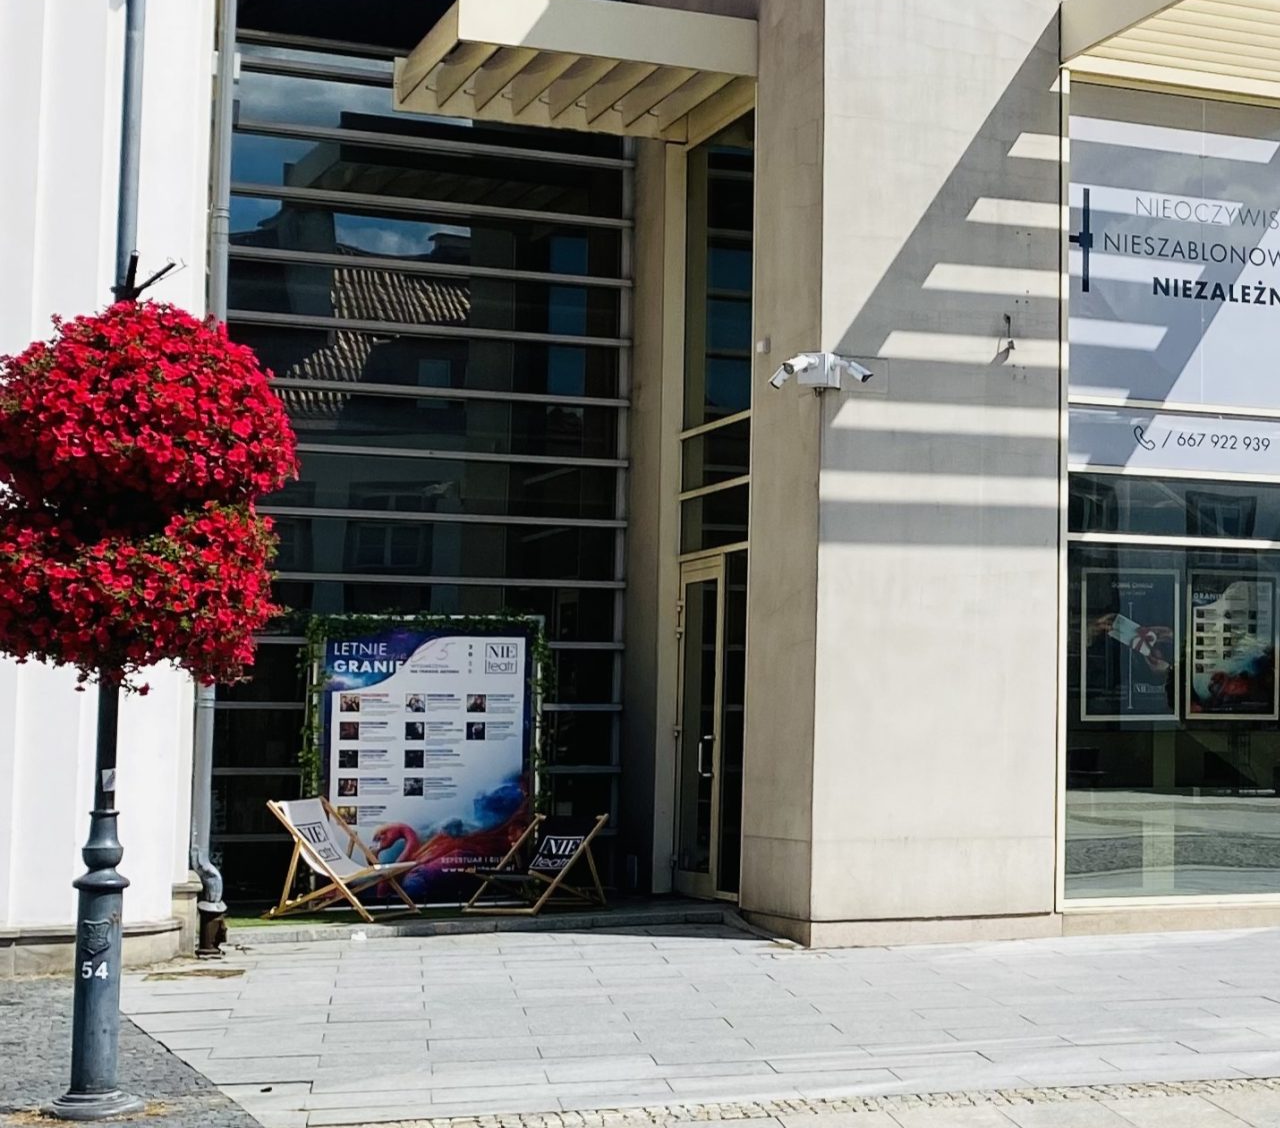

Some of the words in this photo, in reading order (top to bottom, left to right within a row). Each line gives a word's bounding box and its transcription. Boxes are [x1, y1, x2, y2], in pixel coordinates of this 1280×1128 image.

[1176, 433, 1206, 448] 667
[1210, 435, 1238, 450] 922
[1242, 437, 1271, 452] 939
[333, 642, 388, 656] LETNIE
[81, 960, 109, 980] 54
